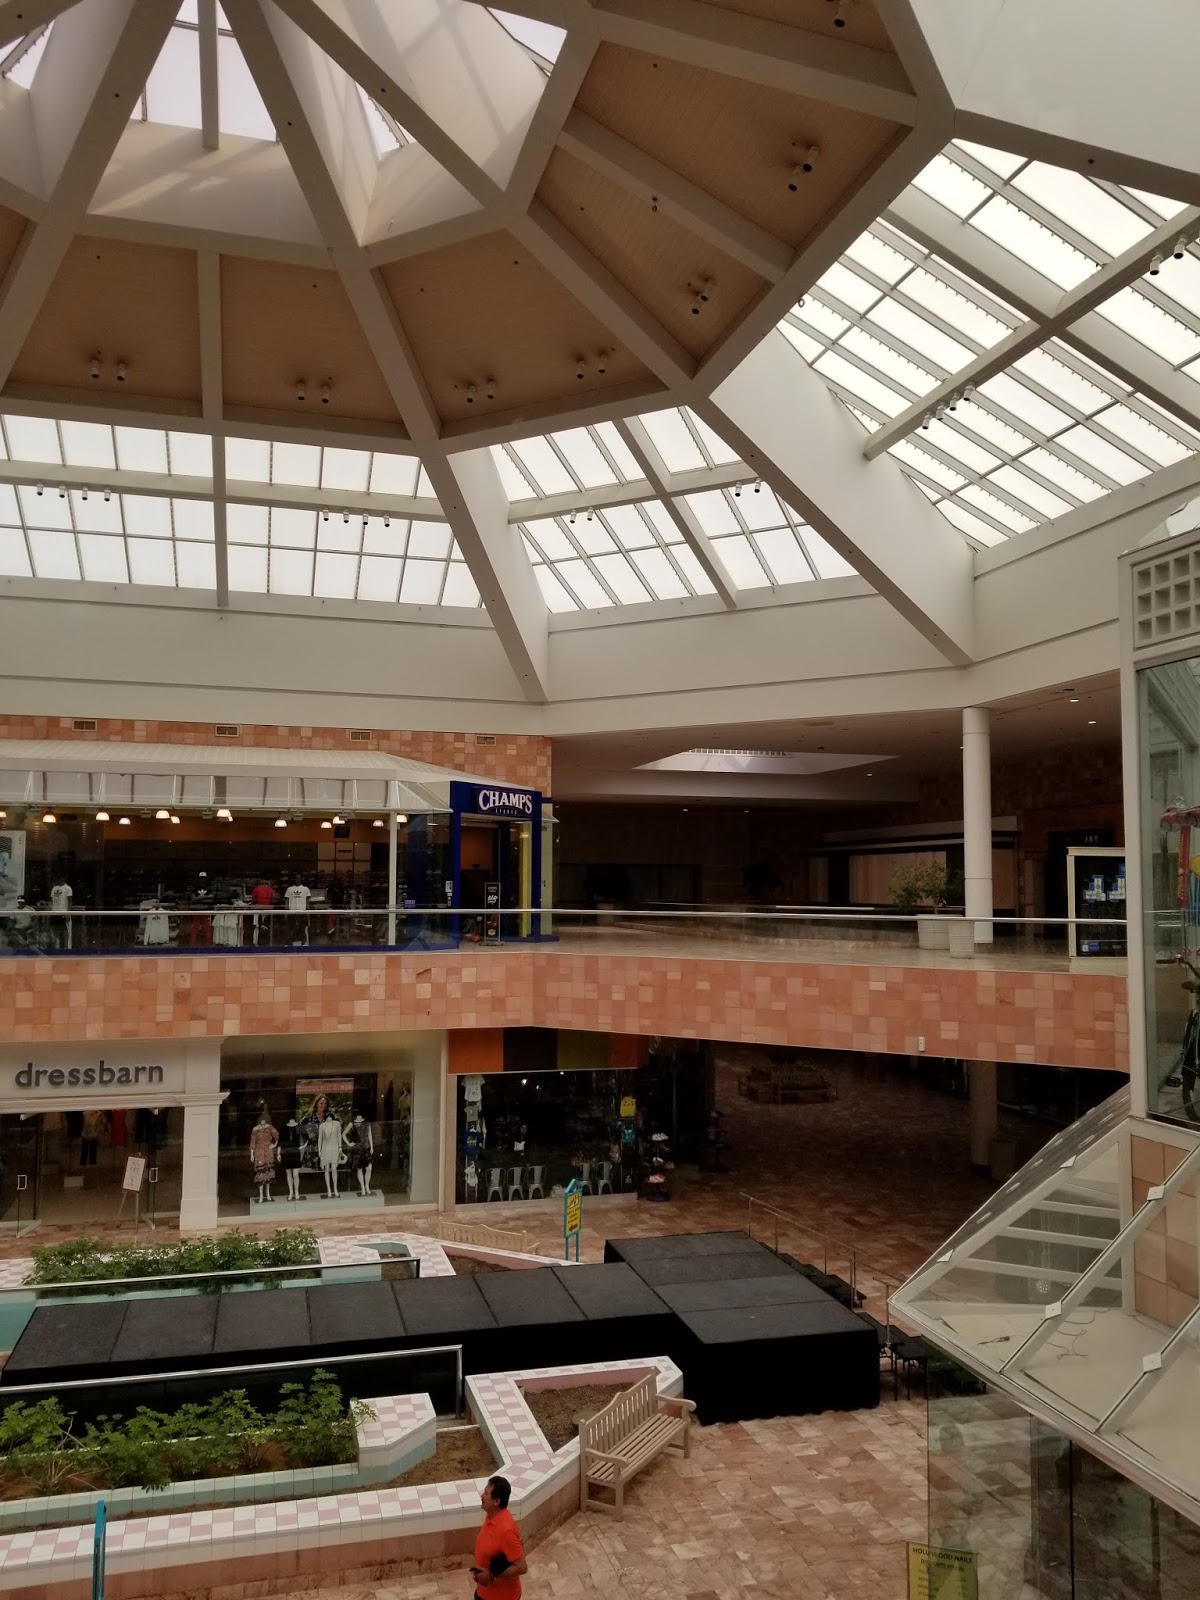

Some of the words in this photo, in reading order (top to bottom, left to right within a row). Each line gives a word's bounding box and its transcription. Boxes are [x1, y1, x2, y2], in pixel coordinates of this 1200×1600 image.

[479, 790, 533, 814] CHAMPS
[15, 1060, 164, 1087] dressbarn
[912, 1547, 953, 1560] HOLLWOOD
[954, 1555, 973, 1564] NAILS
